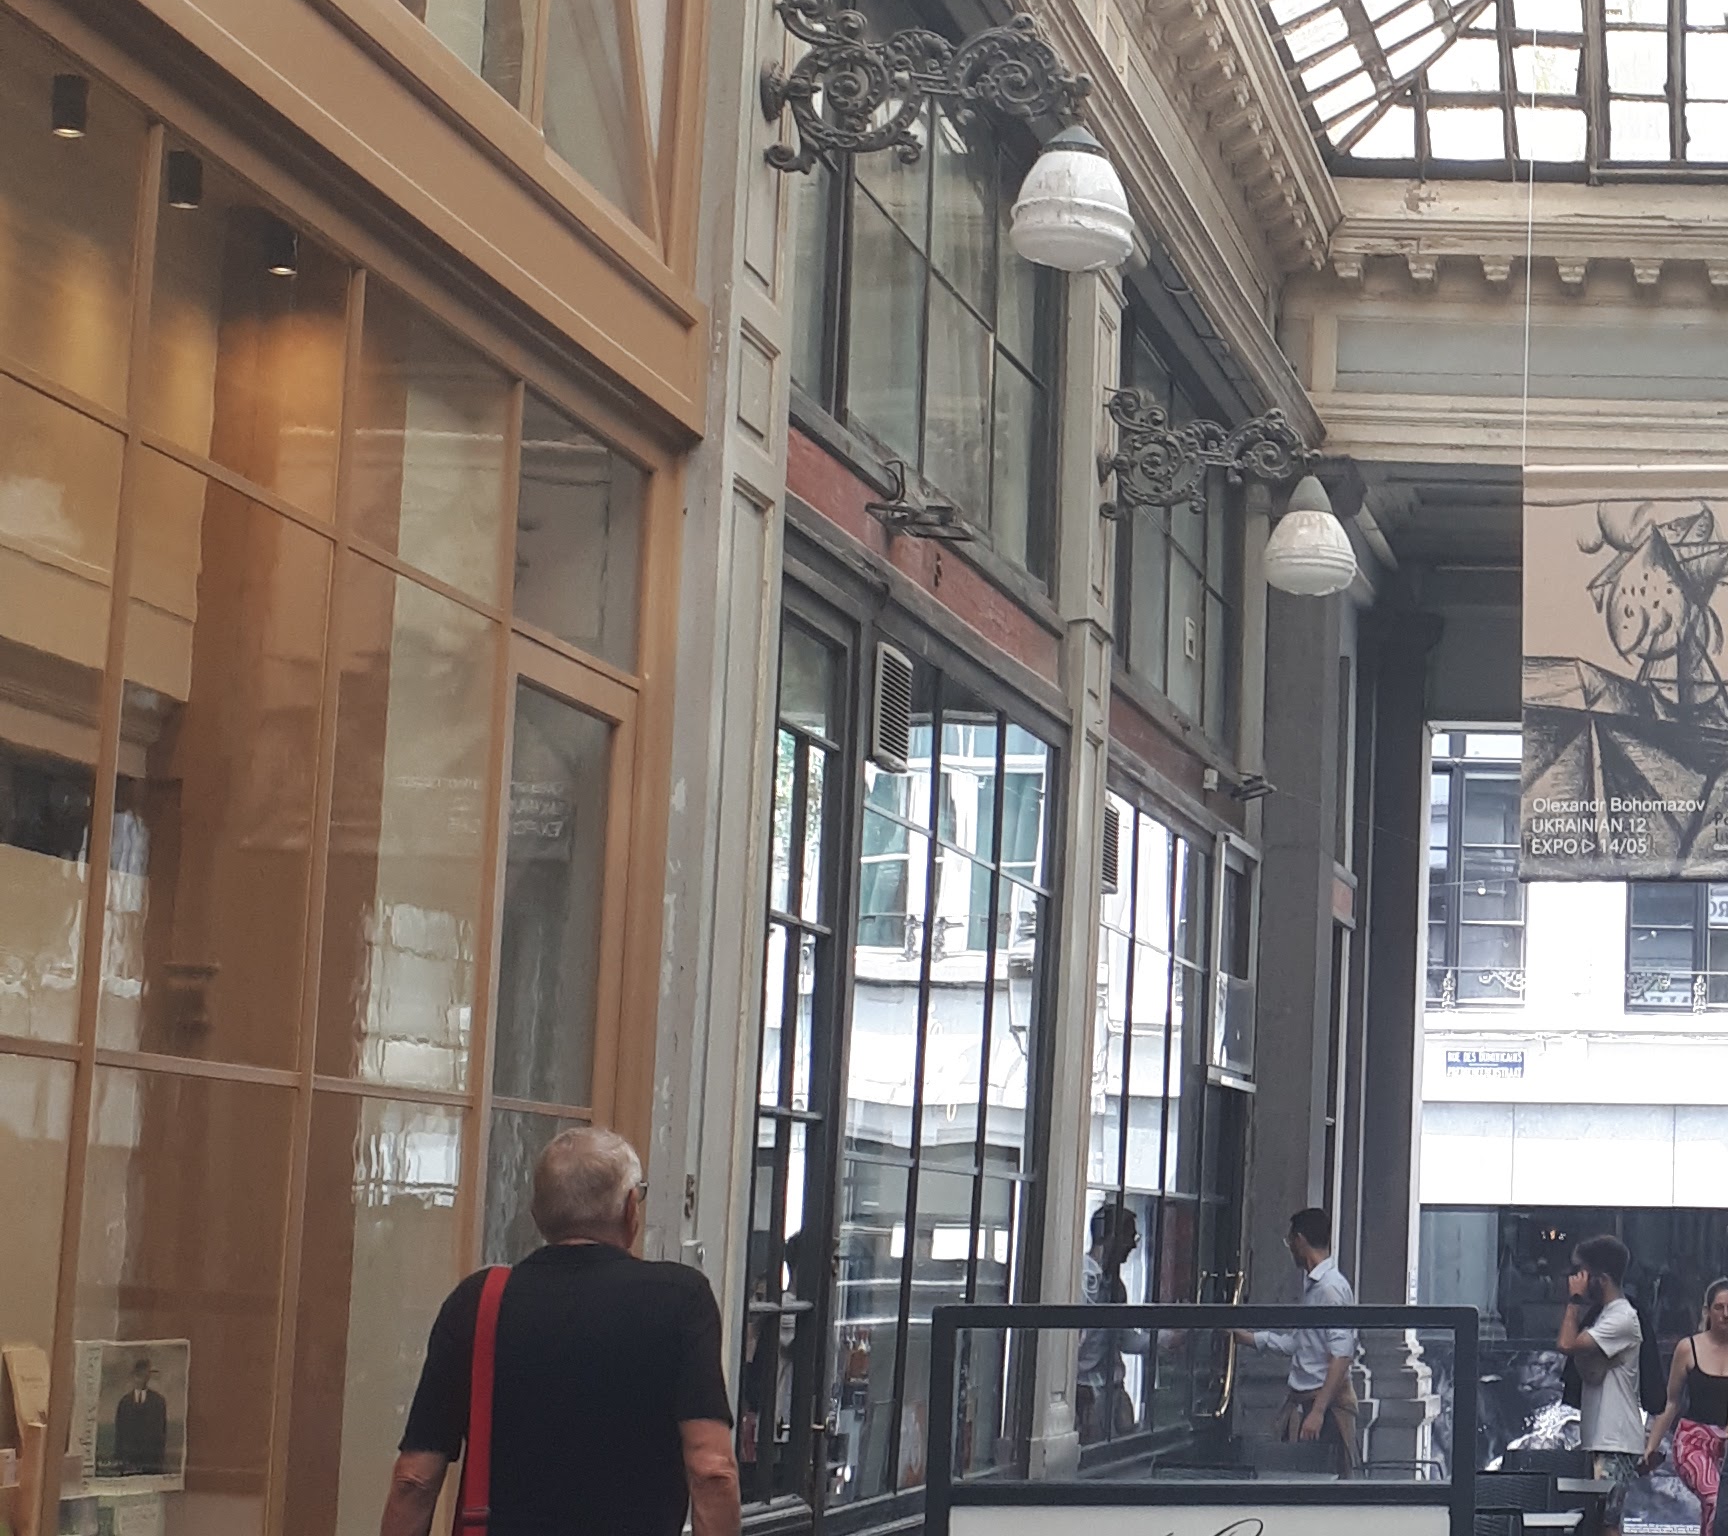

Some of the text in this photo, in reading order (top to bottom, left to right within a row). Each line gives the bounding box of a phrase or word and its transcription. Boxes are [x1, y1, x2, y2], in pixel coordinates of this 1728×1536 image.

[1532, 797, 1706, 813] Olexandr Bohomazov
[1531, 817, 1647, 833] UKRAINIAN 12
[1531, 838, 1648, 855] EXPO 14/05
